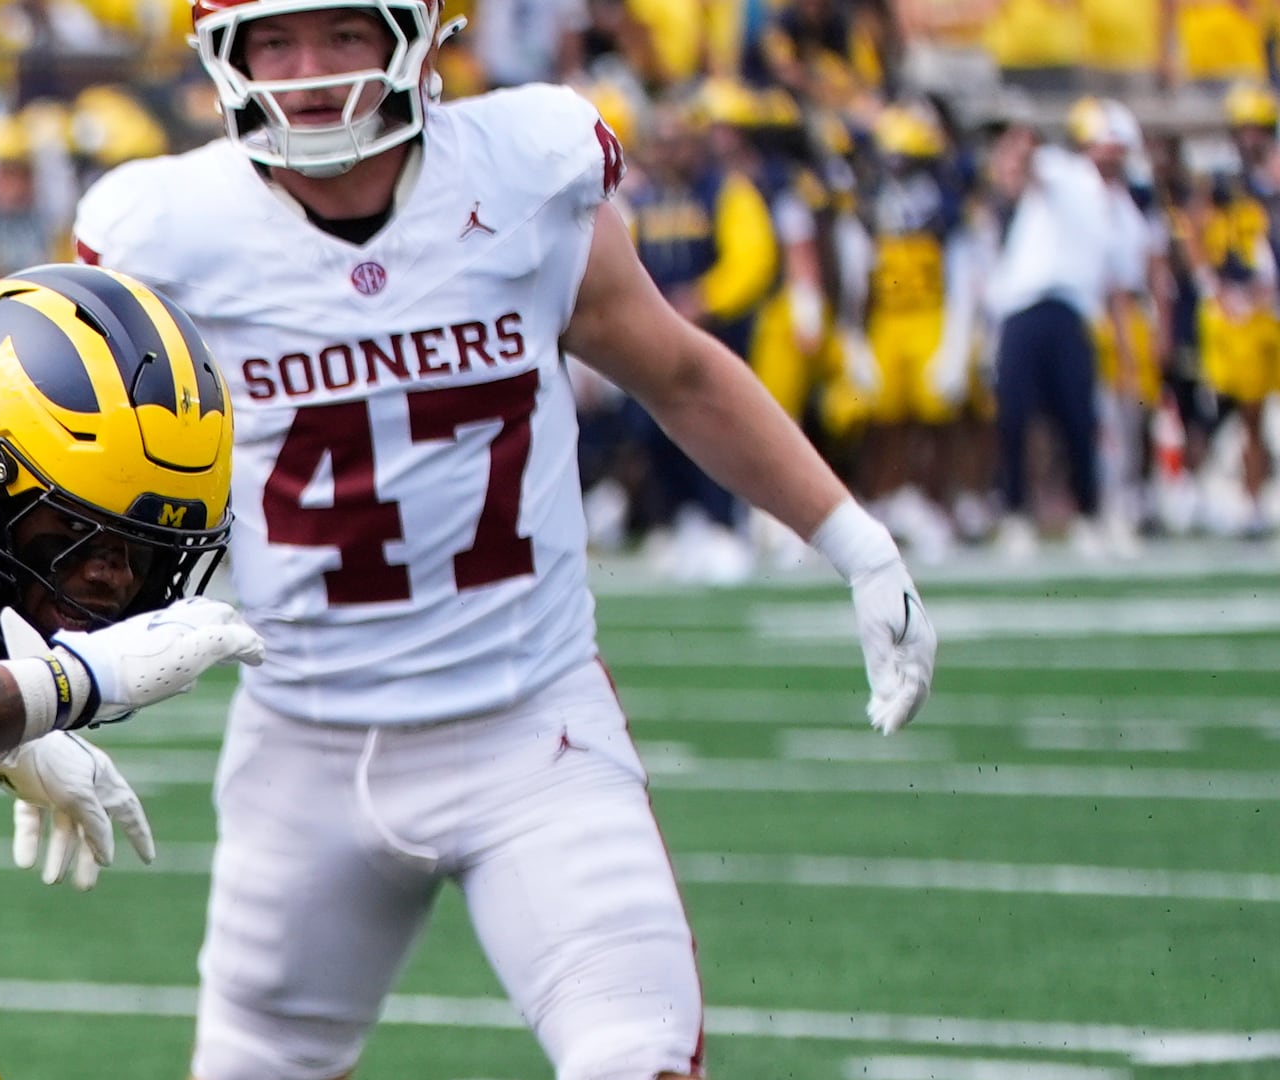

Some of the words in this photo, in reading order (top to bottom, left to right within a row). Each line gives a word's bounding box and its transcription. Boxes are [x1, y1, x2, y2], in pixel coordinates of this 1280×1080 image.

[351, 262, 386, 295] SEC
[242, 312, 525, 400] SOONERS
[158, 502, 188, 528] M
[262, 368, 539, 609] 47
